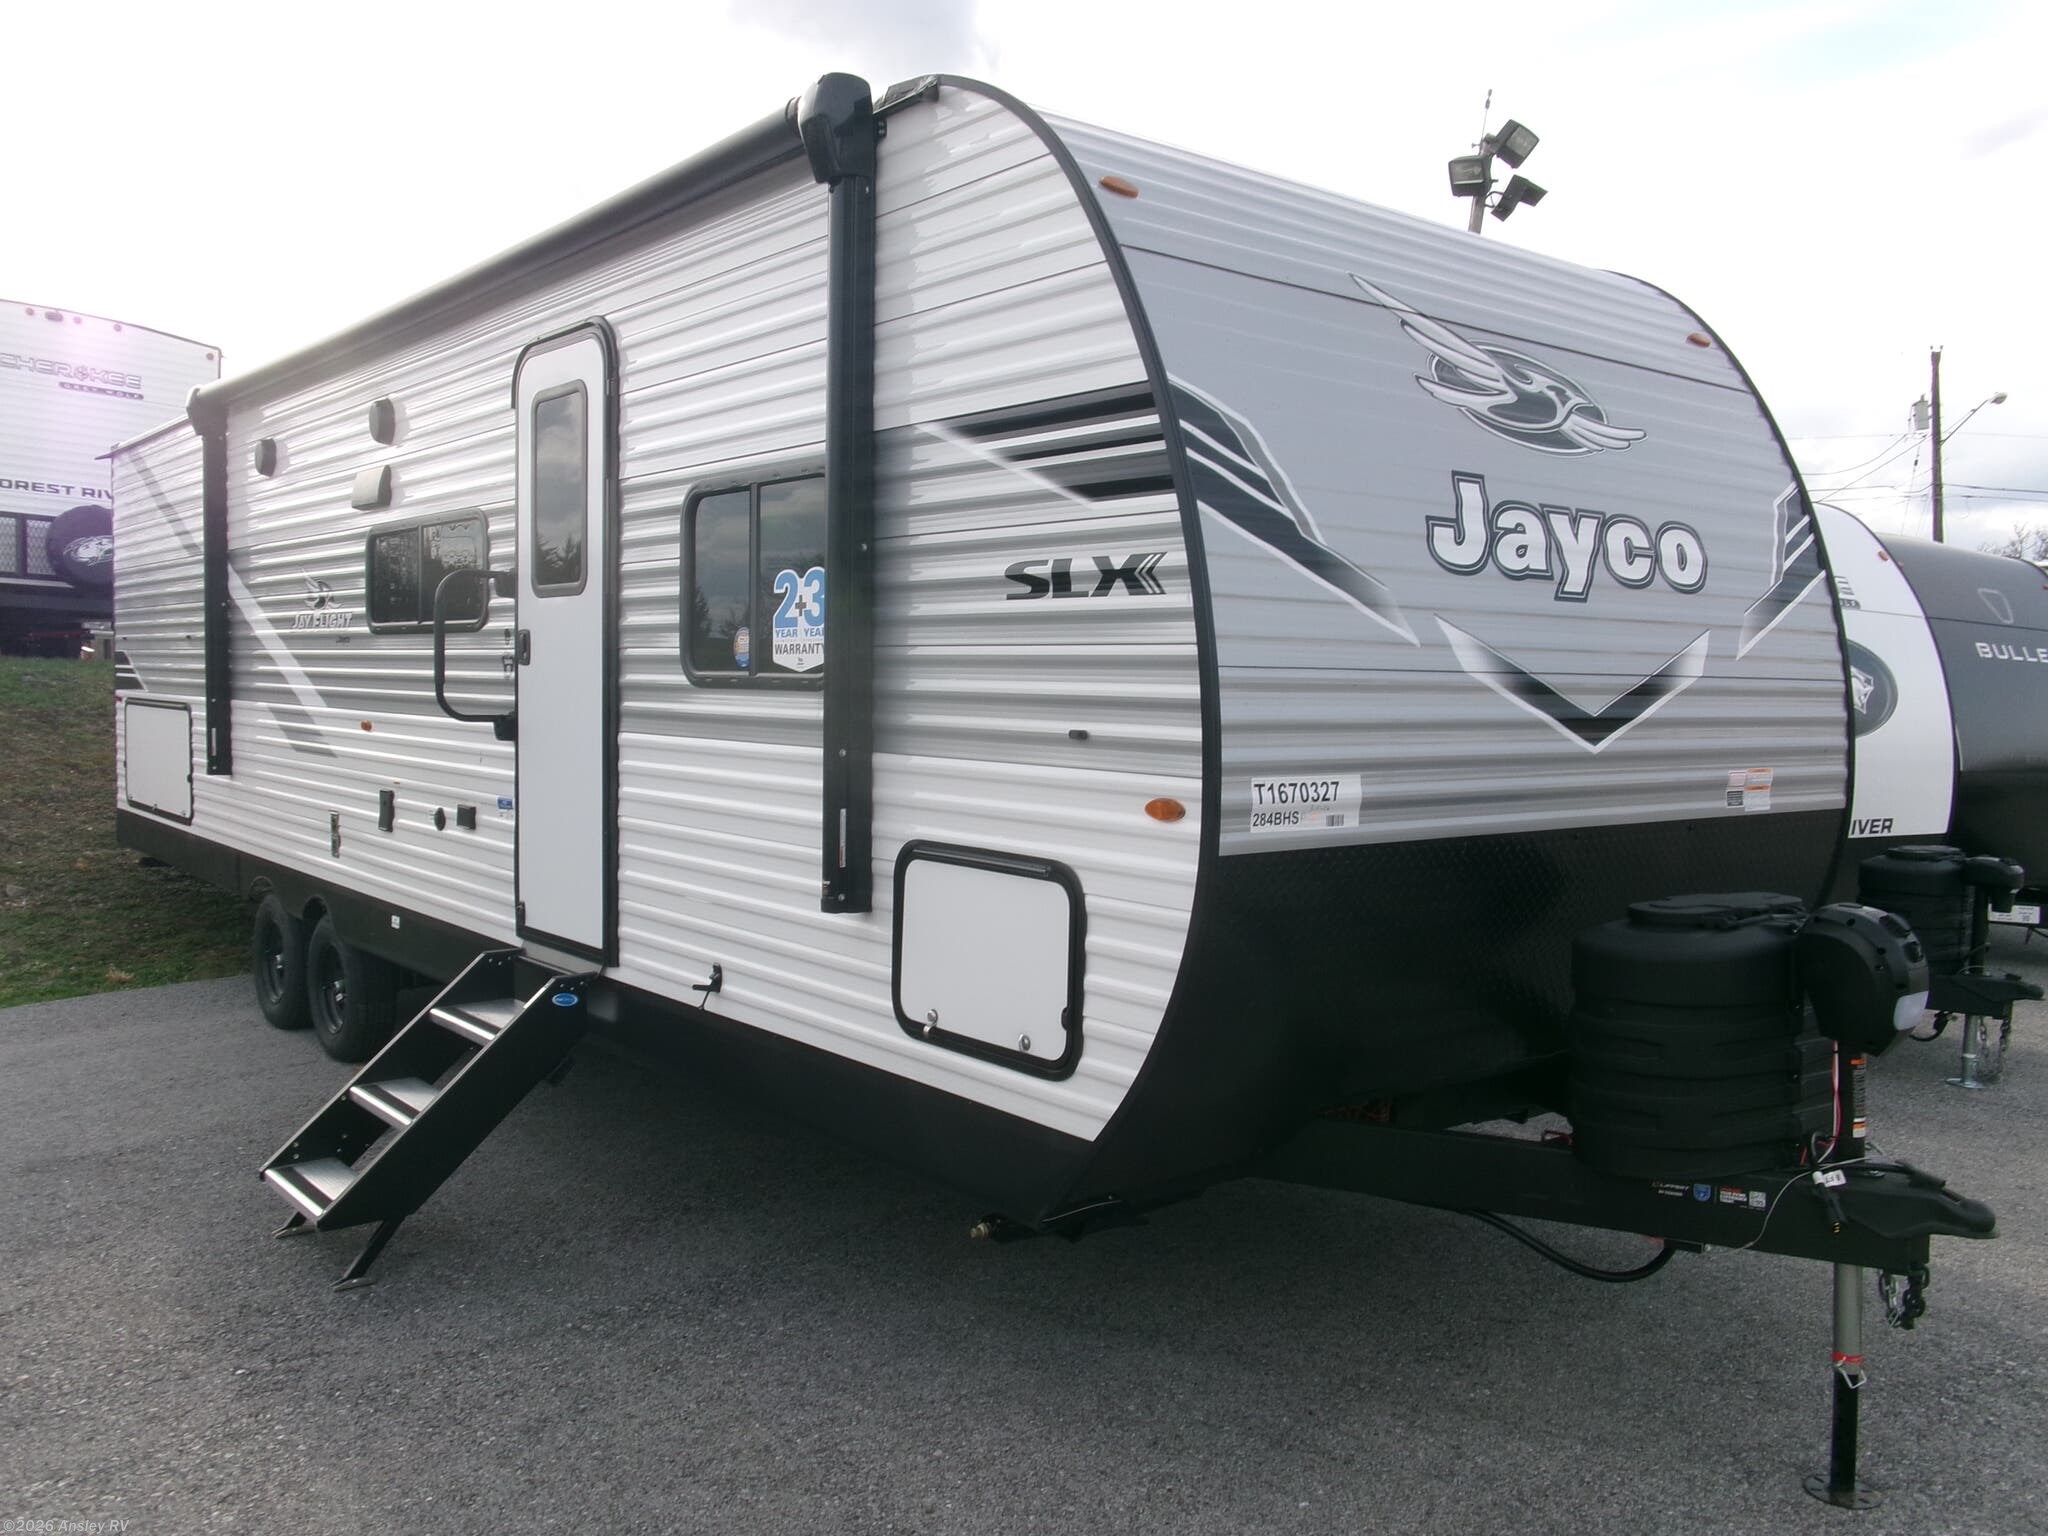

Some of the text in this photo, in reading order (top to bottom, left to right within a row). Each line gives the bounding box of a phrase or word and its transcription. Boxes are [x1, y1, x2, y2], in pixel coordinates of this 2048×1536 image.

[1425, 470, 1708, 603] Jayco
[1004, 551, 1168, 600] SLX
[313, 611, 352, 629] FLIGHT
[775, 628, 798, 638] YEAR
[1253, 781, 1340, 805] T1670327
[1252, 810, 1299, 827] 284BHS
